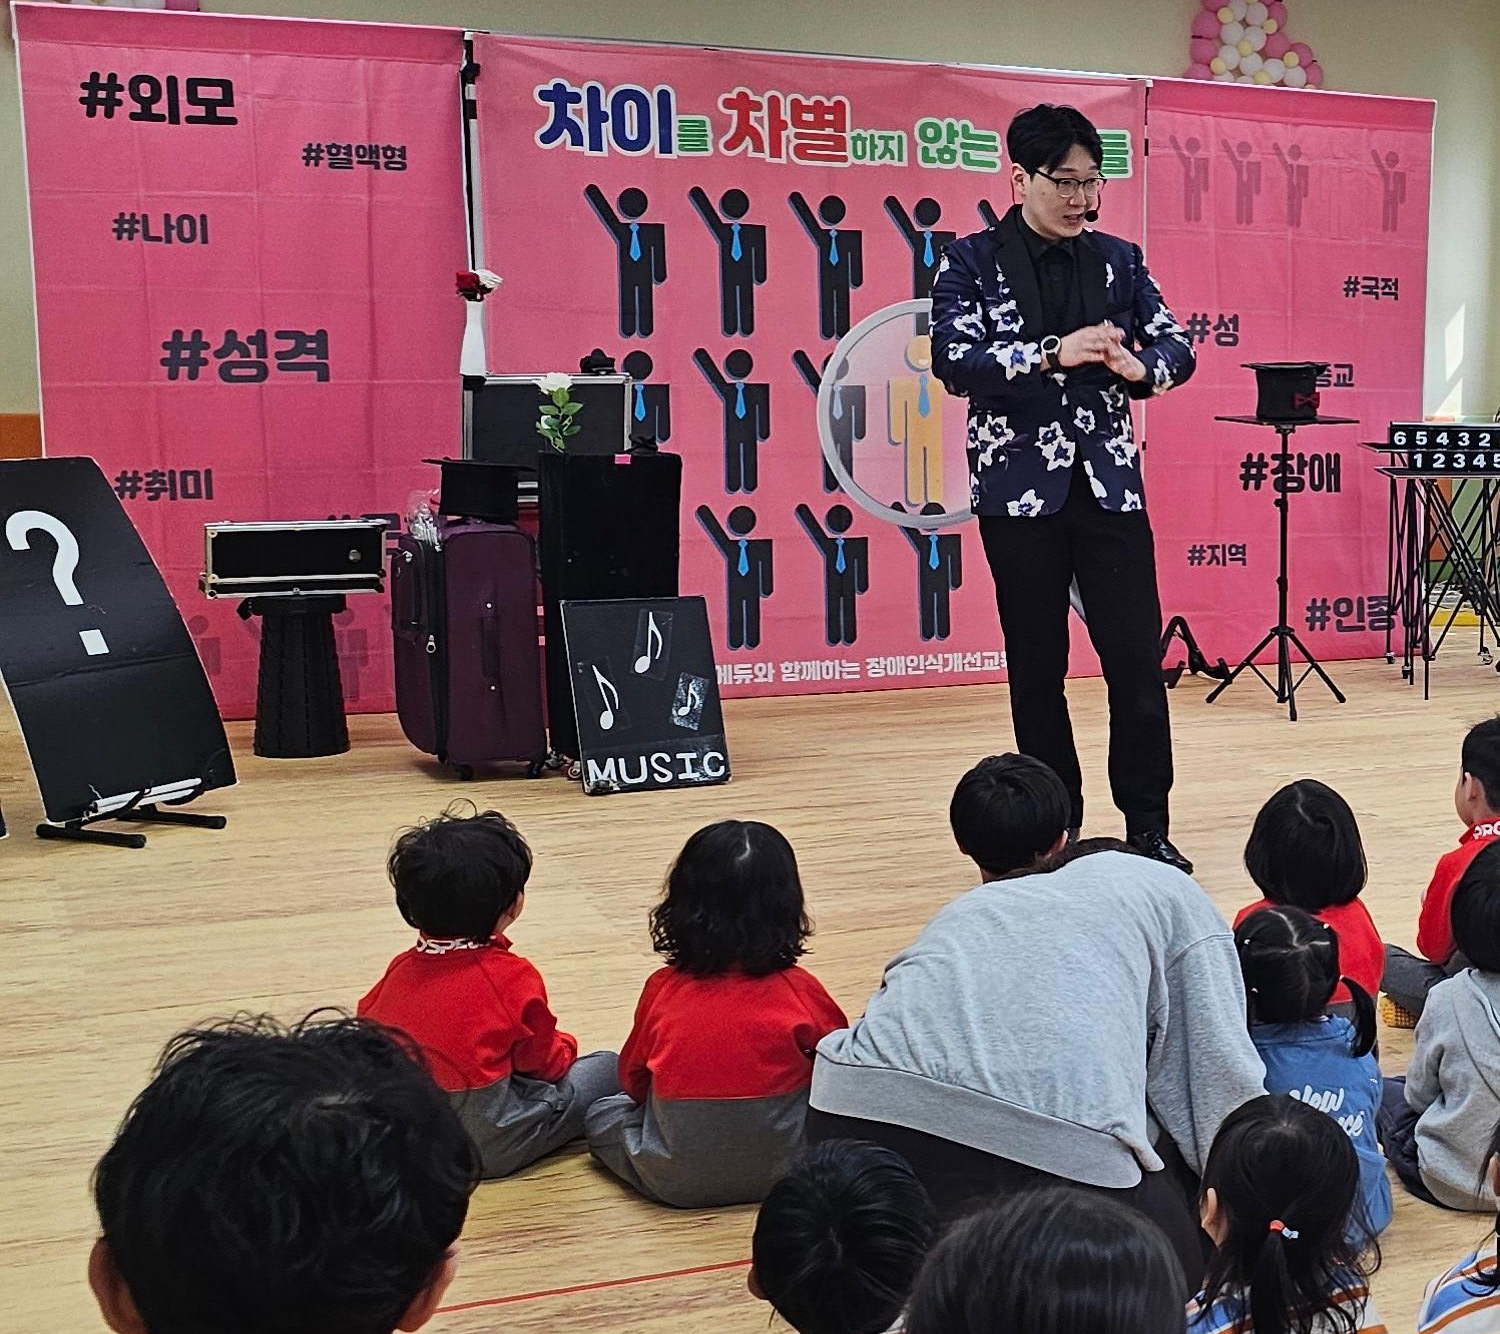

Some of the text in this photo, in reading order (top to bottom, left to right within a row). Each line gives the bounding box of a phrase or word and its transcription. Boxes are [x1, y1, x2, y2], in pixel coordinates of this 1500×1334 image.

[79, 71, 238, 126] #외모
[536, 81, 711, 156] 차이를
[720, 89, 905, 164] 차별하지
[917, 120, 1000, 170] 않는
[302, 142, 408, 171] #혈액형
[112, 212, 209, 245] #나이
[1343, 275, 1399, 301] #국적
[1186, 312, 1239, 347] #성
[160, 328, 331, 384] #성격
[114, 468, 214, 502] #취미
[1239, 452, 1342, 494] #장애
[1187, 543, 1248, 568] #지역
[1305, 596, 1396, 632] #인종
[780, 657, 861, 683] 함께하는
[587, 751, 725, 785] MUSIC
